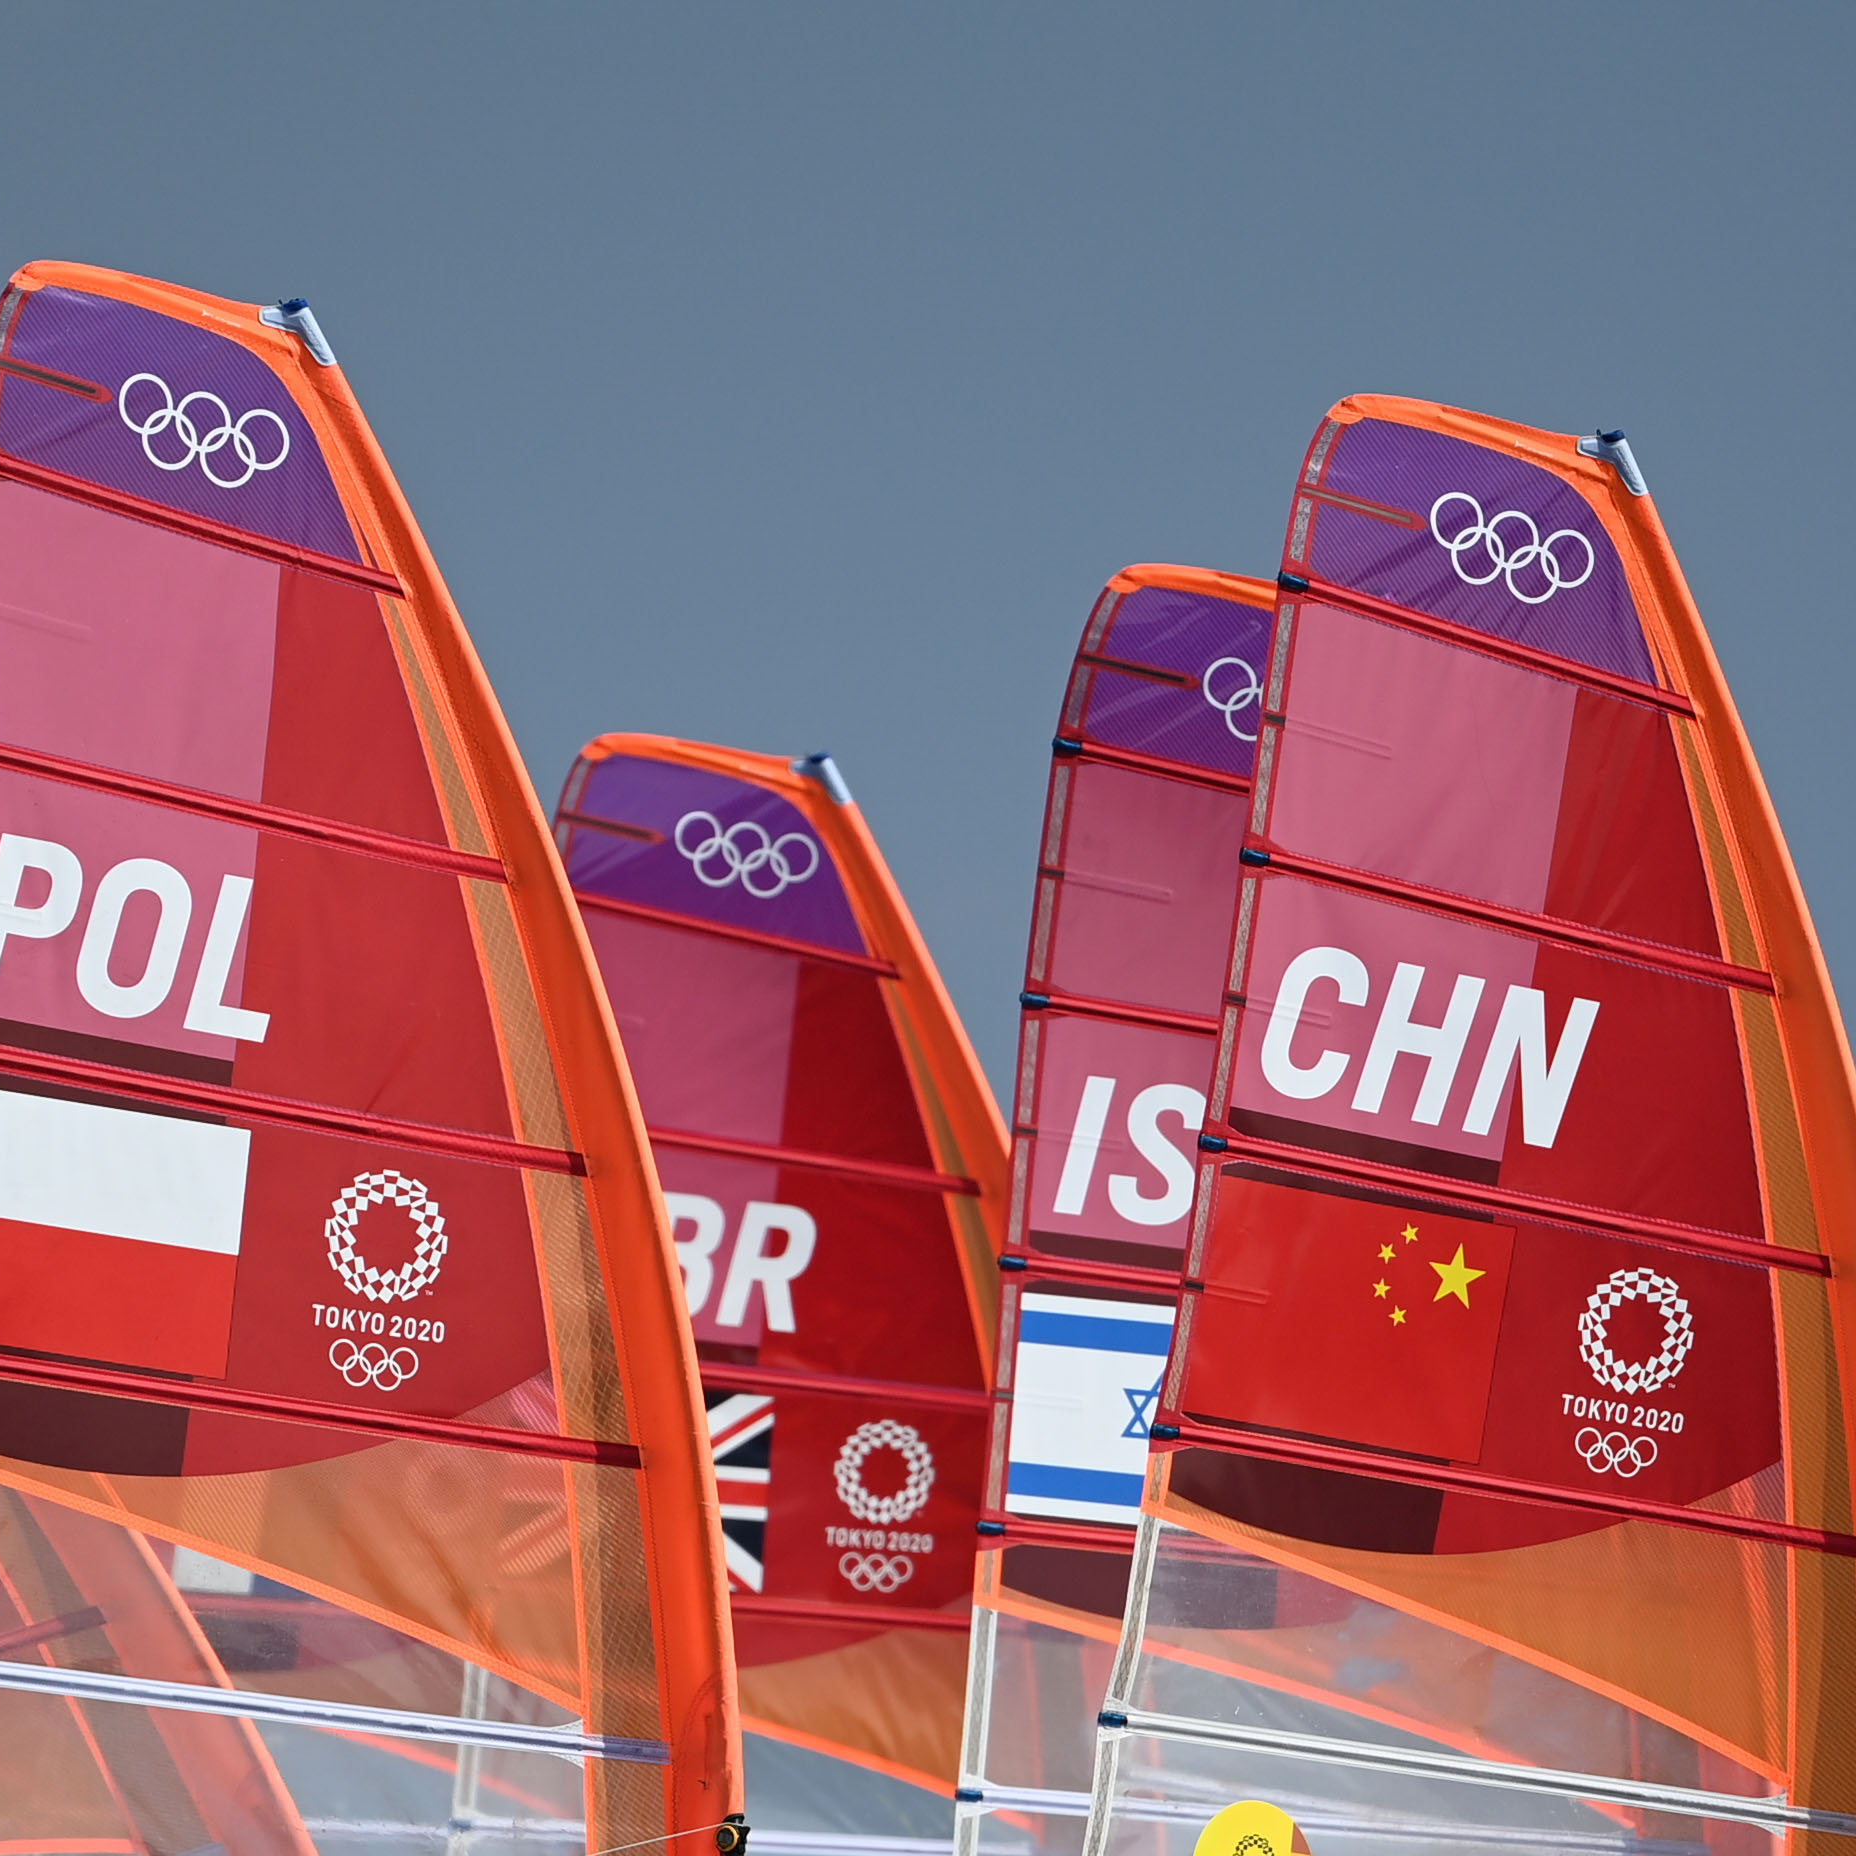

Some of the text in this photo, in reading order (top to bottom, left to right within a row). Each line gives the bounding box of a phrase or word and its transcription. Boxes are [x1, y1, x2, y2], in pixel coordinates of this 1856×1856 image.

[1259, 946, 1600, 1149] CHN
[1052, 1075, 1206, 1225] IS
[663, 1190, 817, 1333] BR
[312, 1303, 445, 1343] TOKYO 2020
[1562, 1393, 1684, 1434] TOKYO 2020
[825, 1526, 934, 1553] TOKYO 2020
